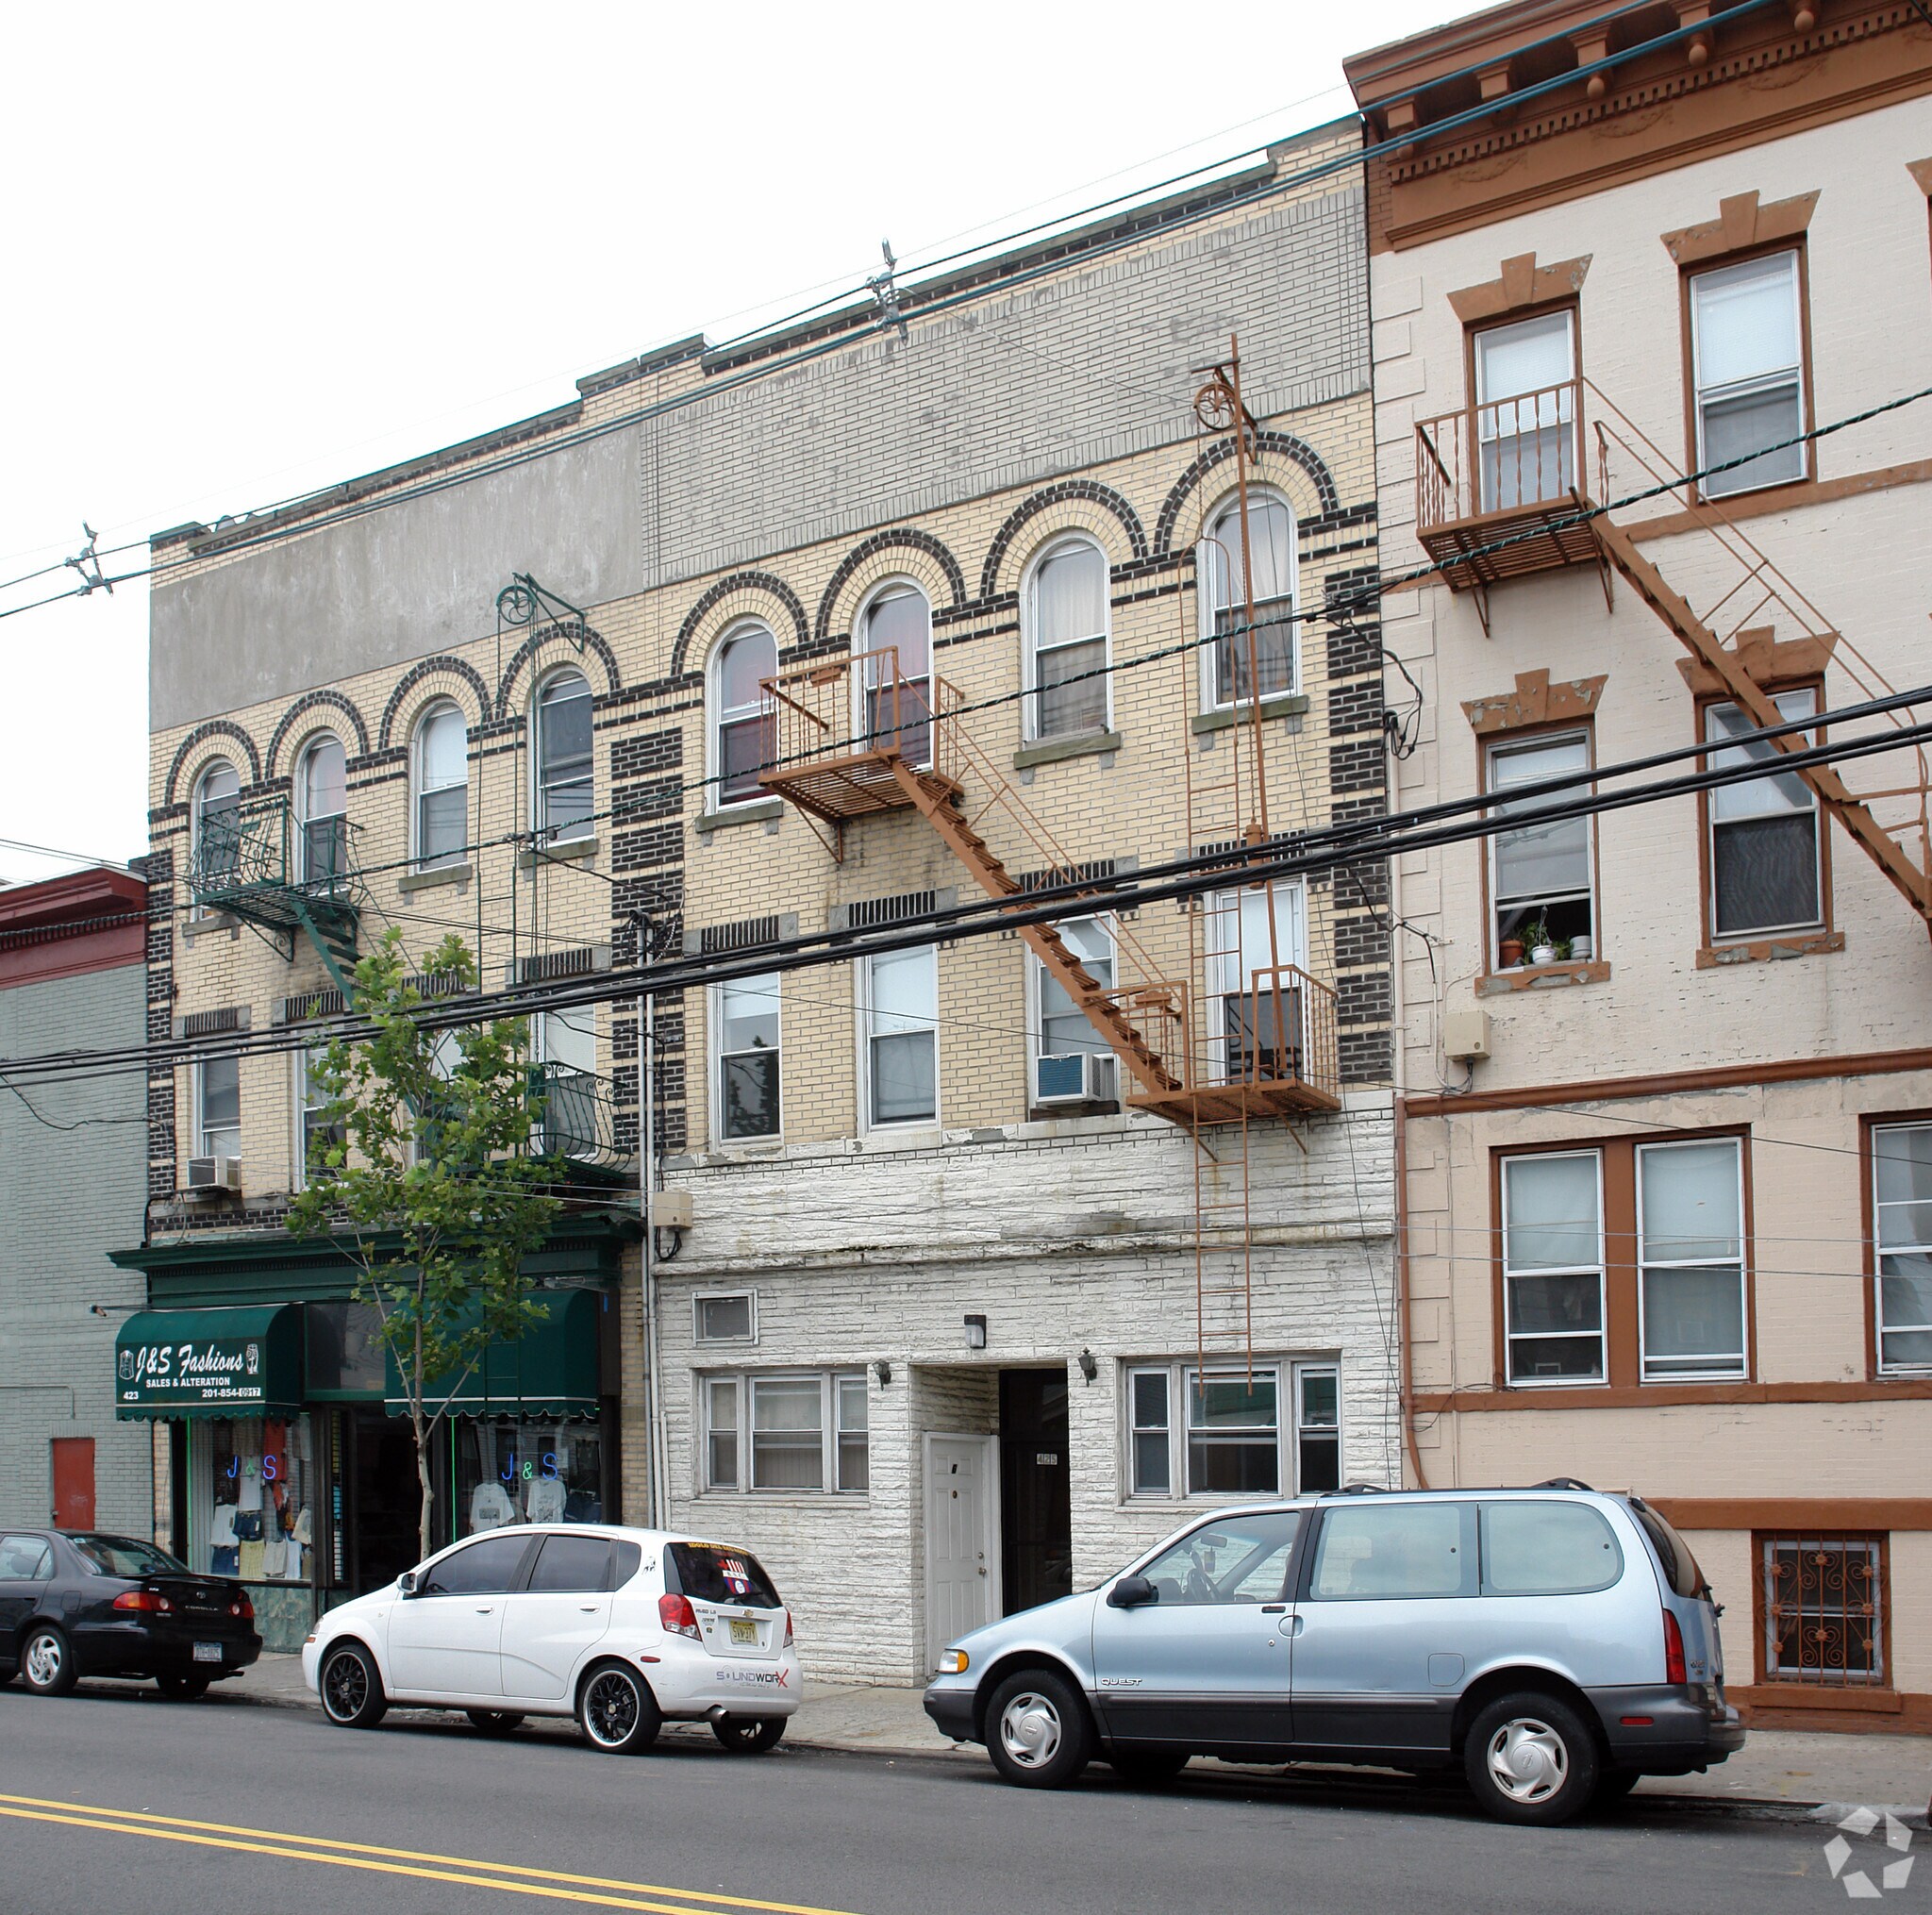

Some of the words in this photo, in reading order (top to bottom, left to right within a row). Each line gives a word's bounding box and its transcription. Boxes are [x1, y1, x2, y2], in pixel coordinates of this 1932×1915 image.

[135, 1346, 172, 1382] J&S
[178, 1344, 243, 1376] Fashions
[145, 1377, 171, 1389] SALES
[172, 1377, 179, 1387] &
[179, 1376, 231, 1388] ALTERATION
[123, 1390, 140, 1401] 423
[1037, 1454, 1058, 1464] 425
[227, 1456, 239, 1478] J
[263, 1456, 276, 1479] S
[502, 1453, 513, 1480] J
[522, 1461, 533, 1480] &
[542, 1453, 558, 1480] S
[1101, 1677, 1142, 1687] QUEST
